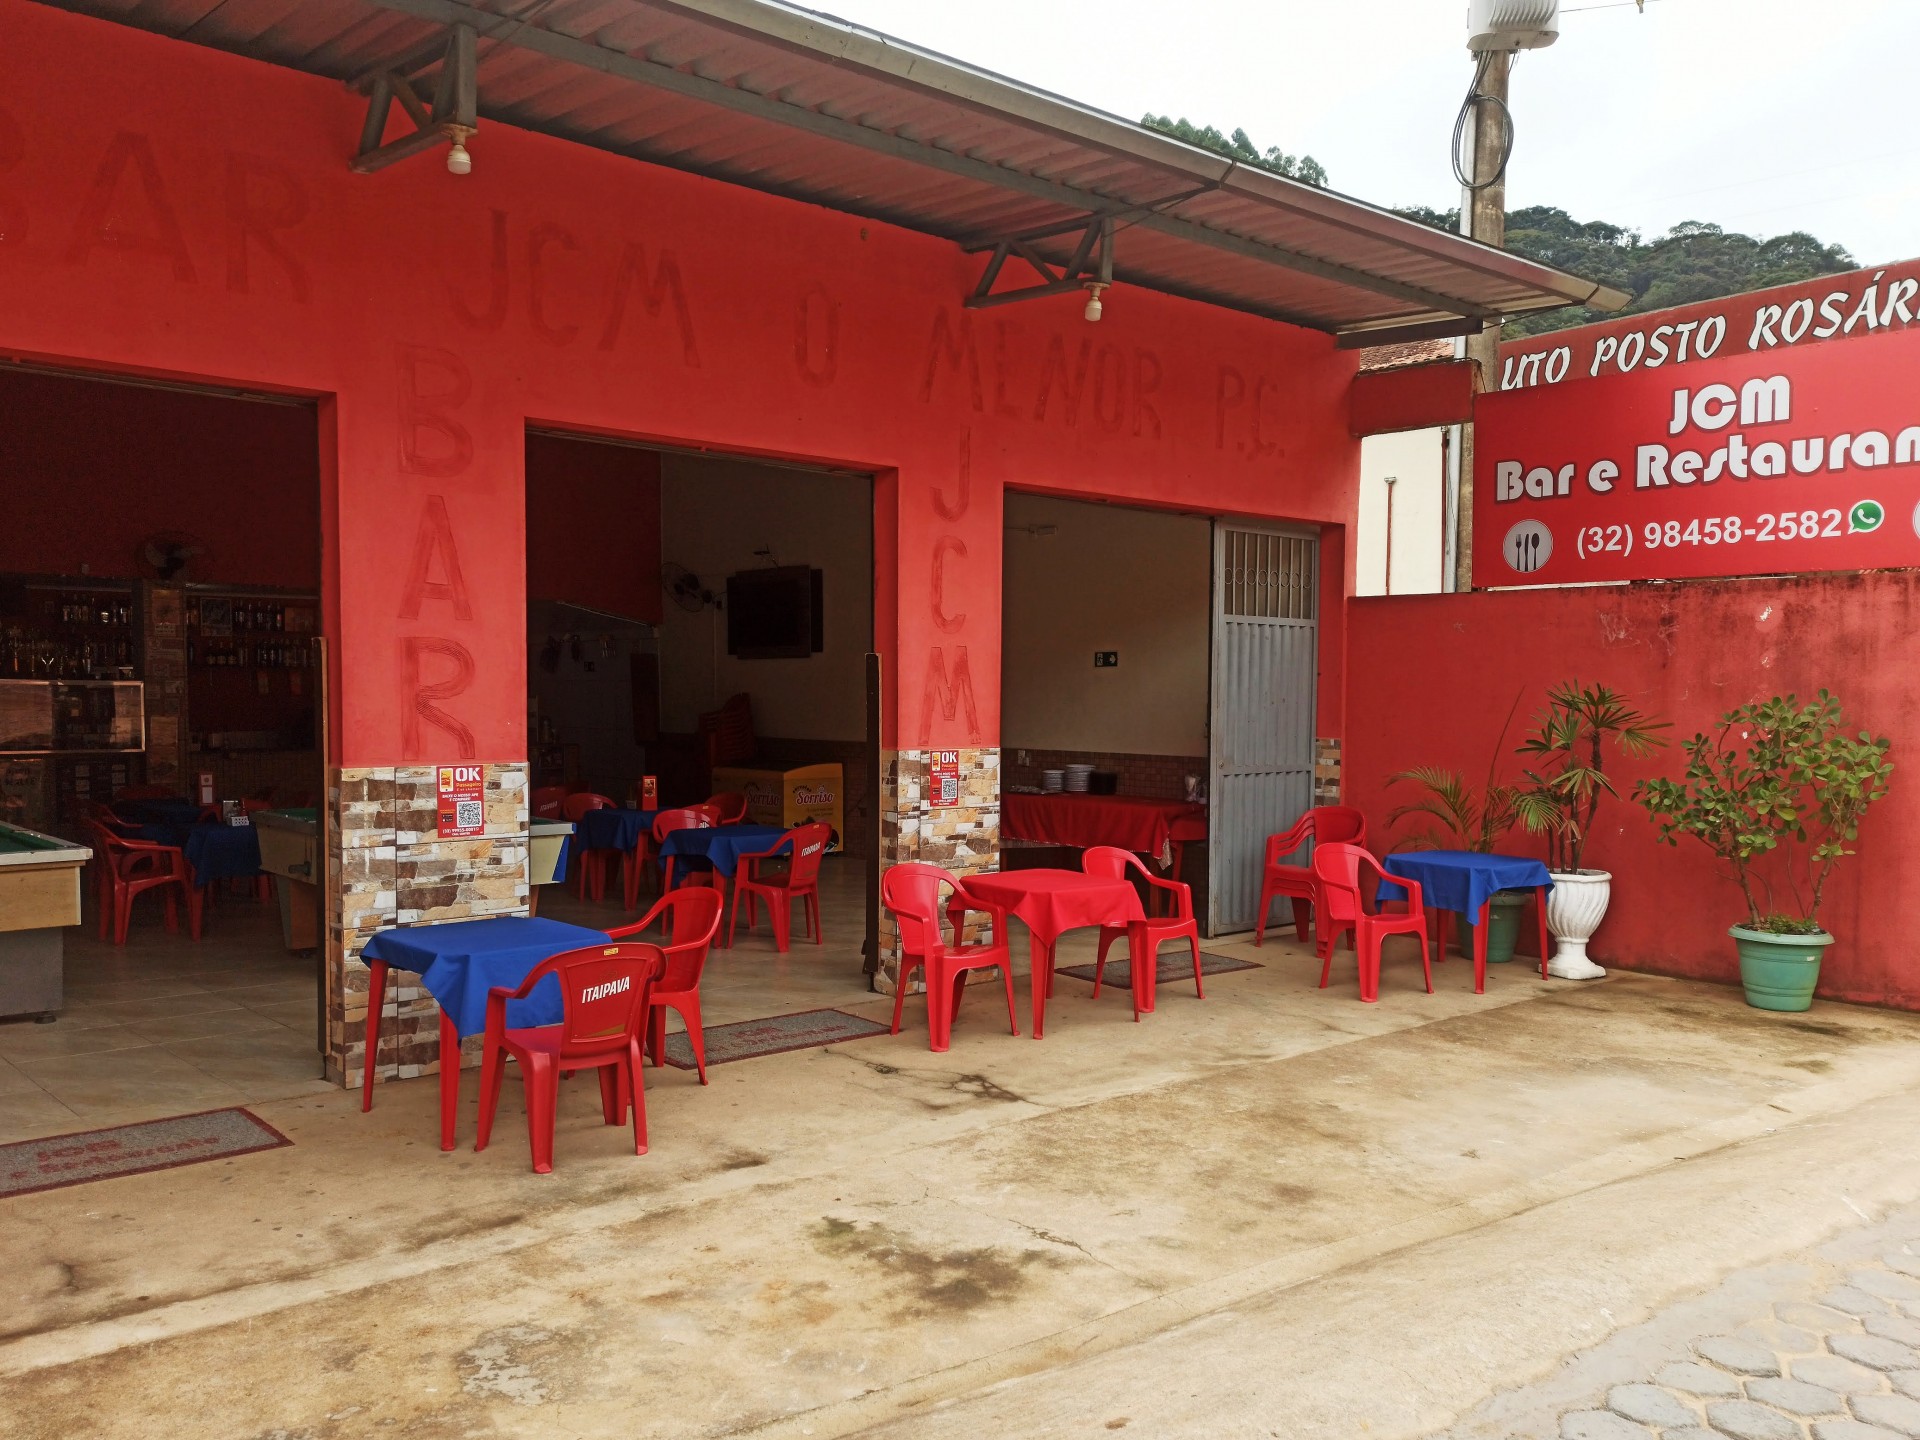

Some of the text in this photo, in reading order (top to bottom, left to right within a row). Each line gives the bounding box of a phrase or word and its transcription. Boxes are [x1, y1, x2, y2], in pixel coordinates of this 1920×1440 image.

[446, 207, 702, 369] JCM
[793, 280, 841, 389] O
[917, 303, 1164, 441] MENOR
[1590, 315, 1727, 377] POSTO
[1748, 270, 1920, 350] ROSÁR
[1669, 375, 1792, 435] JCM
[1496, 460, 1575, 502] Bar
[1587, 459, 1619, 493] e
[1576, 508, 1843, 559] (32) 98458-2582
[455, 767, 481, 782] OK
[941, 752, 957, 764] OK
[796, 790, 834, 806] Sorriso
[581, 976, 630, 1004] ITAIPAVA
